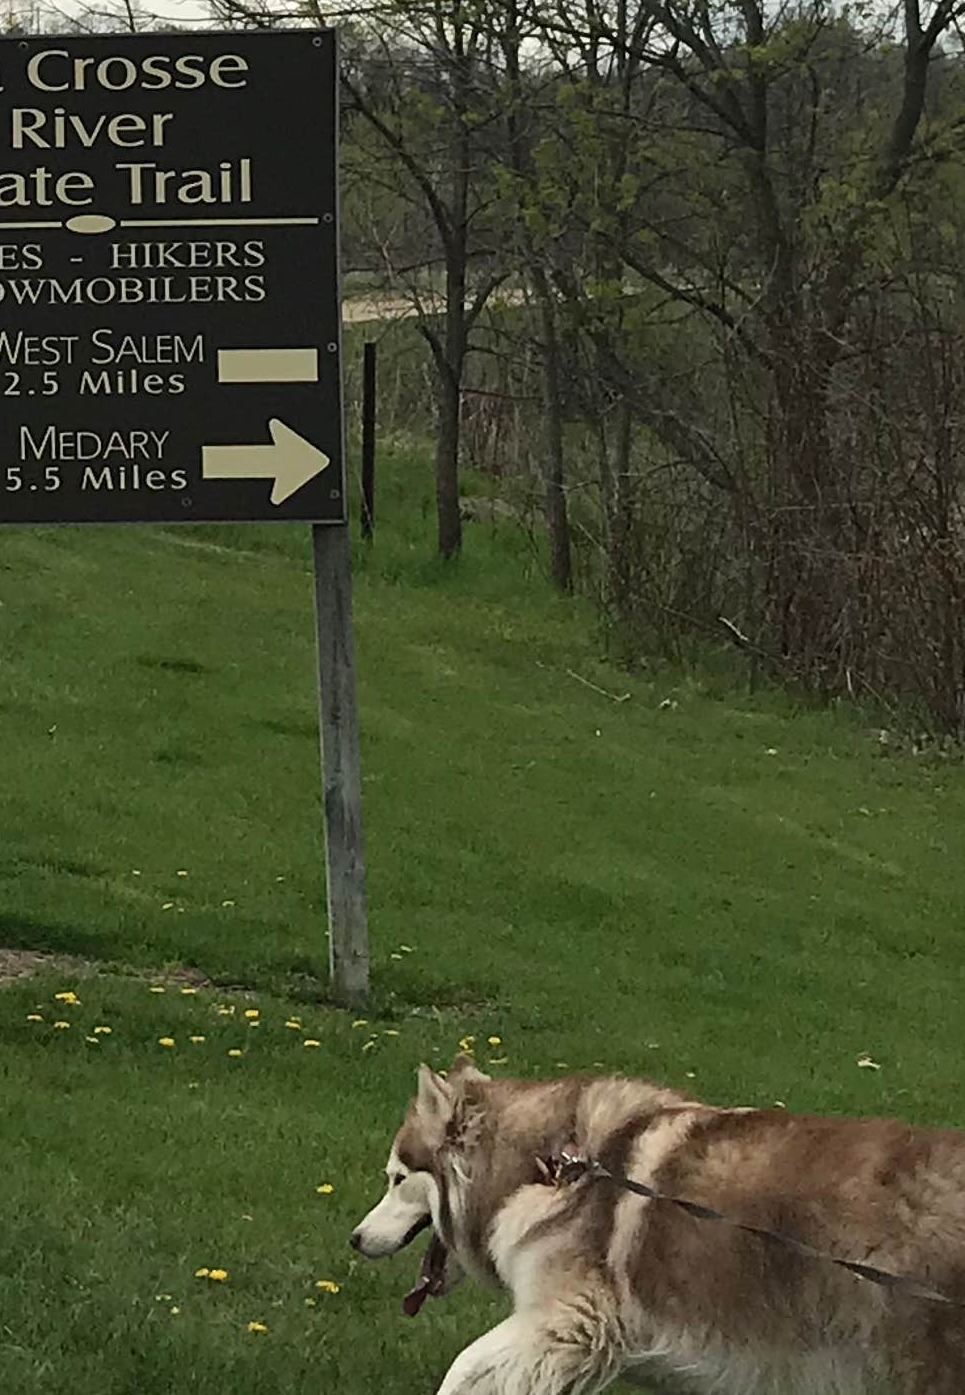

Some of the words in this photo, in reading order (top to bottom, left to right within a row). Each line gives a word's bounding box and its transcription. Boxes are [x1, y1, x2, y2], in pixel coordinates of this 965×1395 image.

[28, 50, 248, 91] Crosse
[13, 108, 173, 148] River
[116, 159, 251, 203] Trail
[111, 241, 264, 268] HIKERS
[92, 329, 203, 364] SALEM
[4, 372, 58, 395] 2.5
[80, 369, 184, 394] Miles
[21, 426, 169, 460] MEDARY
[6, 467, 60, 491] 5.5
[82, 465, 186, 489] Miles
